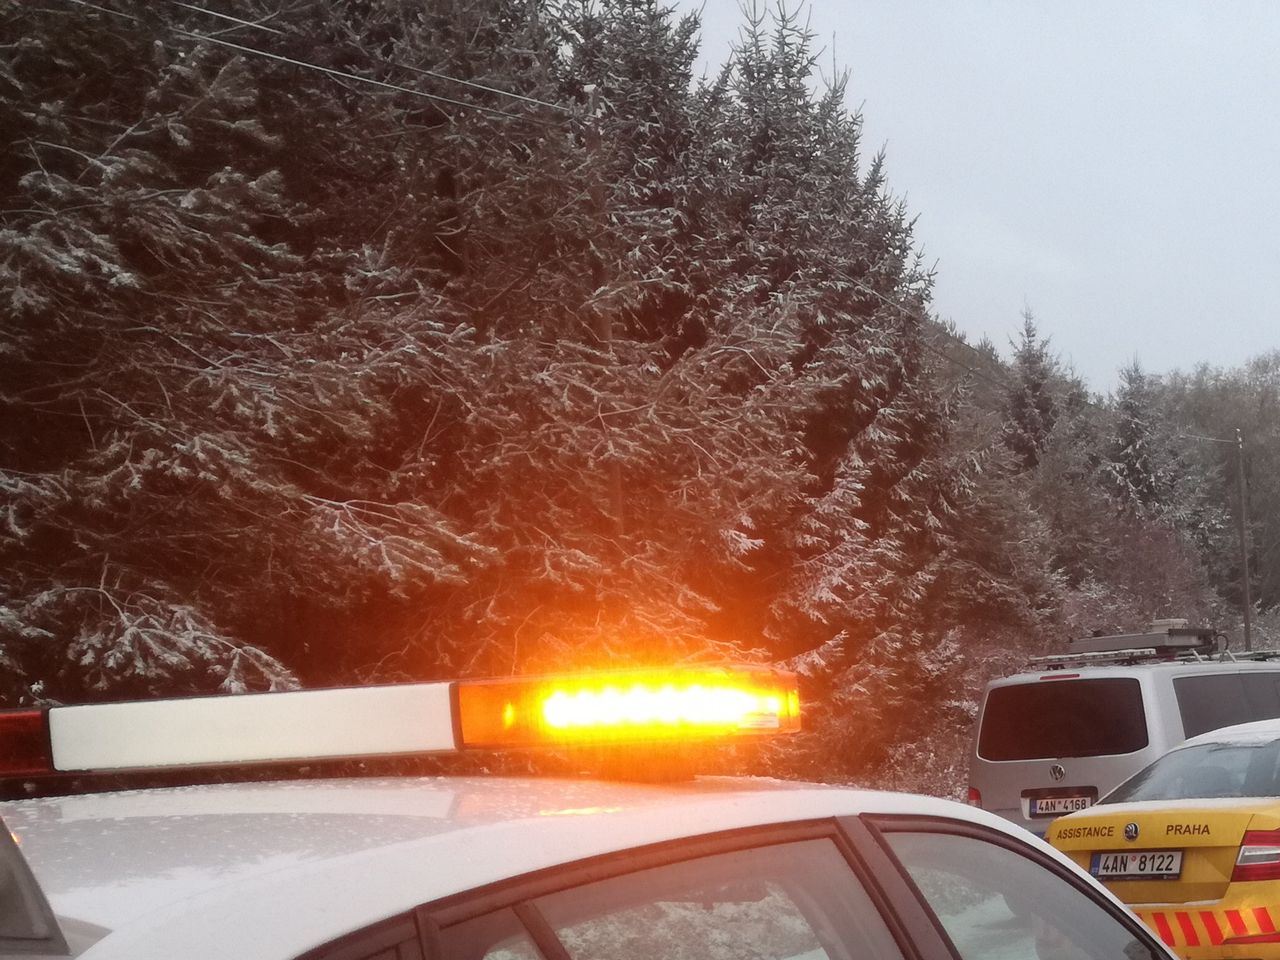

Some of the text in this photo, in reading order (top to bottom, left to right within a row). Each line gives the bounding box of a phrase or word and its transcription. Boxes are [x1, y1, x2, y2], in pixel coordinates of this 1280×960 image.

[1038, 799, 1087, 812] 4AN 4168
[1056, 824, 1211, 840] ASSISTANCE PRAHA
[1102, 854, 1174, 873] 4AN 8122
